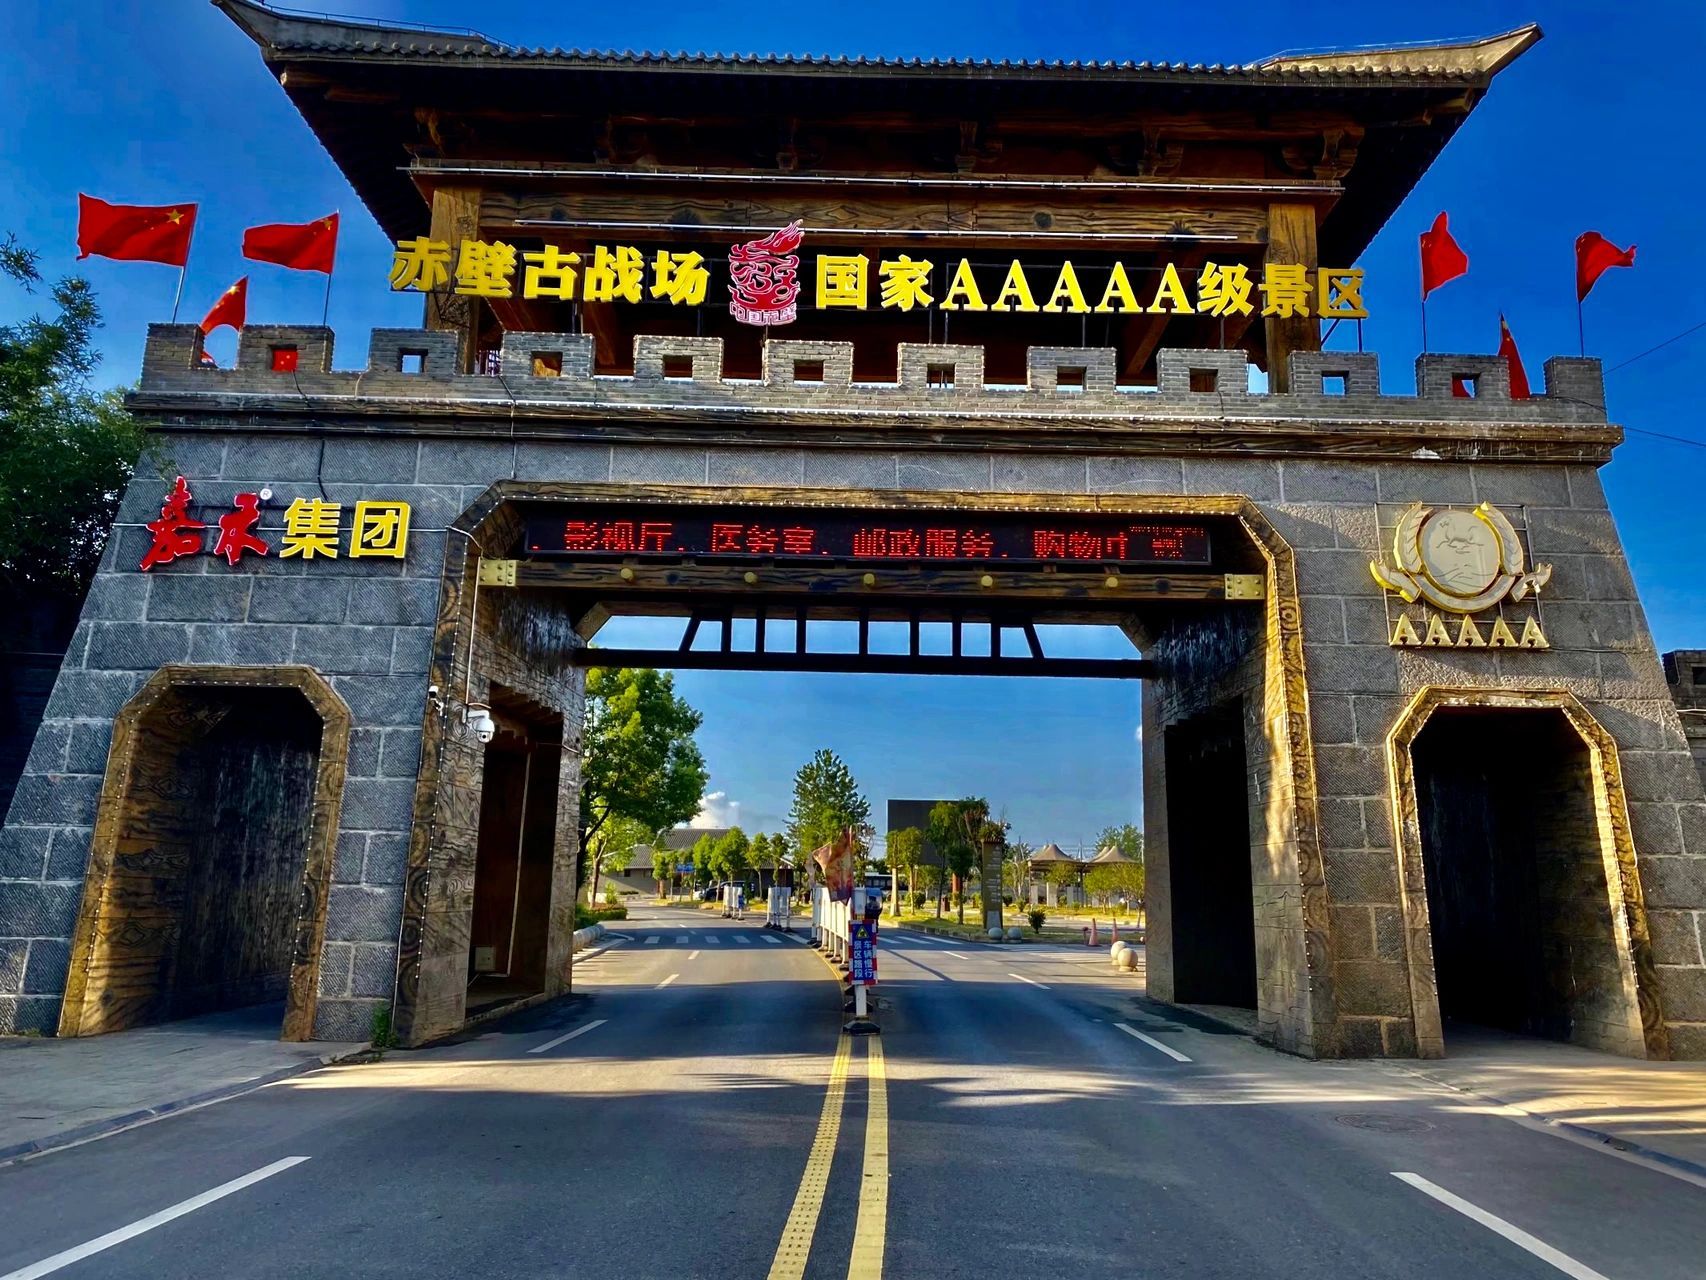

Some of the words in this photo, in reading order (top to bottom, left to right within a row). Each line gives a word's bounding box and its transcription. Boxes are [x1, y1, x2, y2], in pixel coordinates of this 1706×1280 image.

[389, 236, 711, 306] 赤壁古战场
[816, 254, 1368, 318] 国家AAAAA级景区
[1389, 614, 1550, 648] AAAAA
